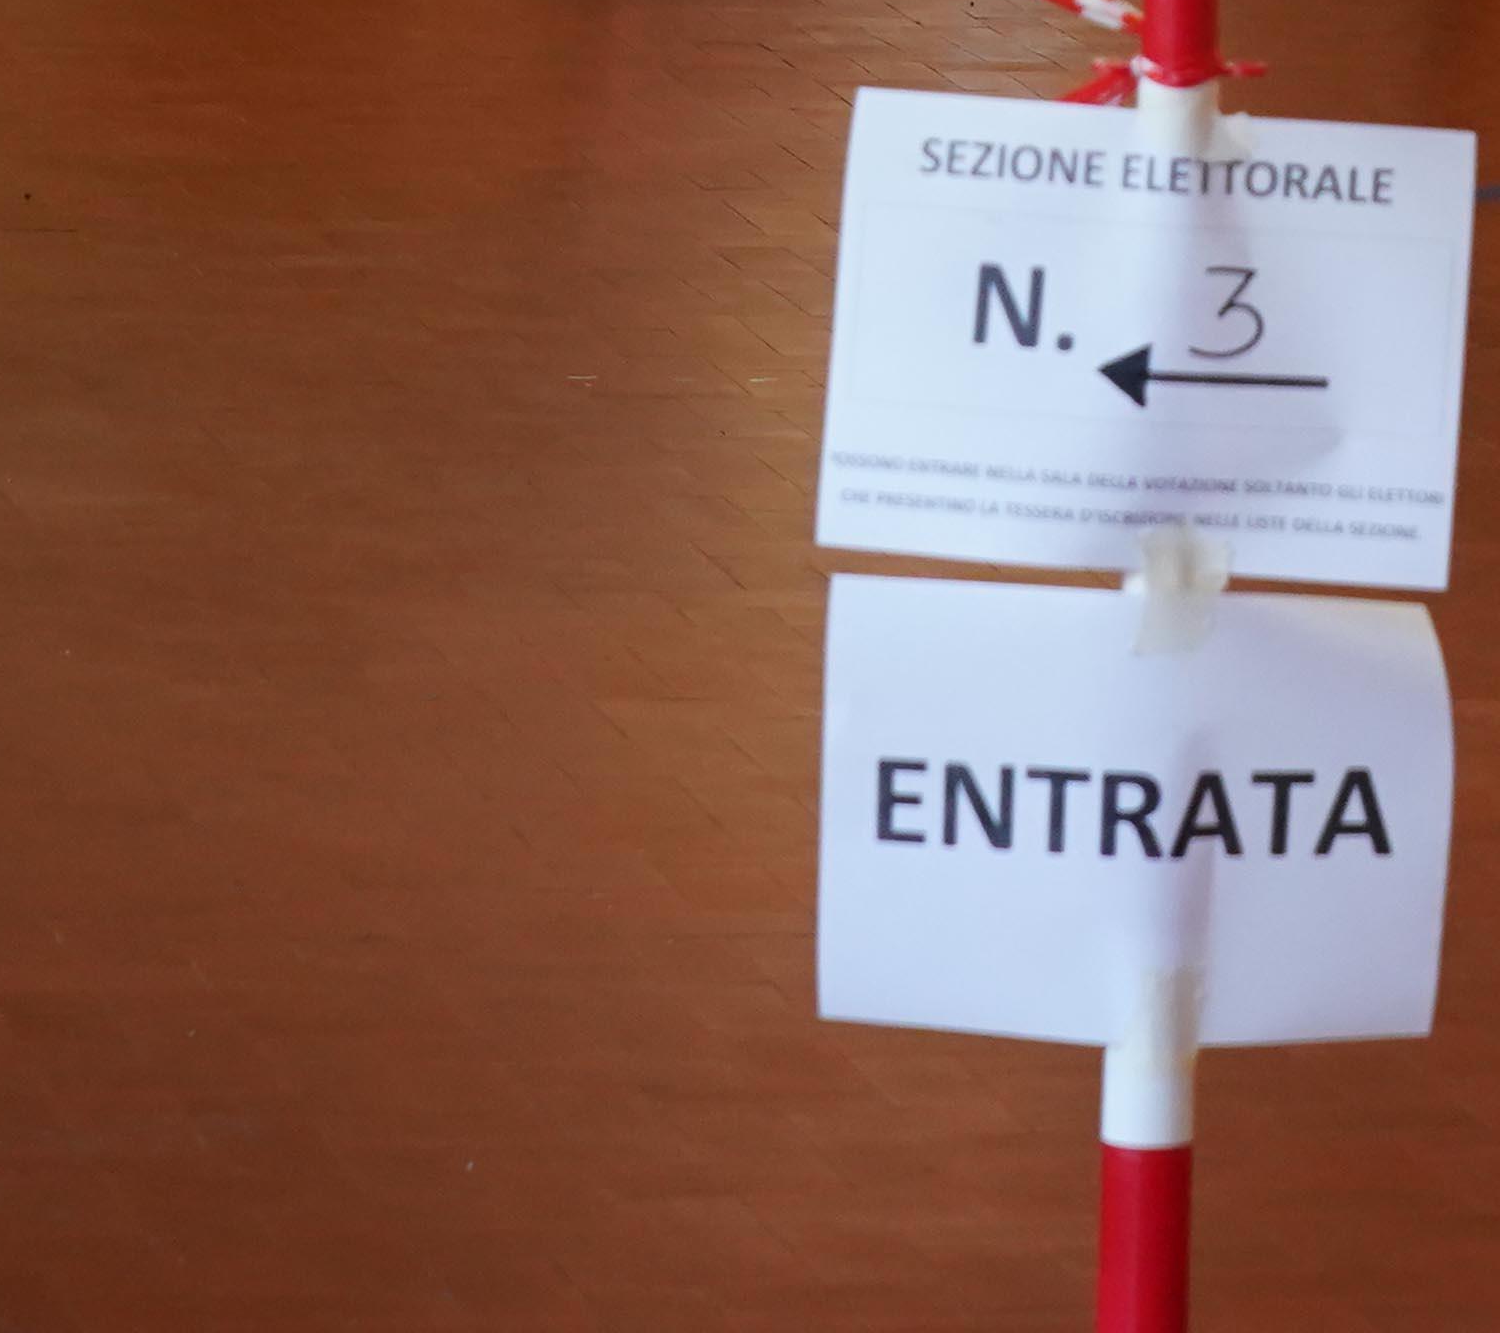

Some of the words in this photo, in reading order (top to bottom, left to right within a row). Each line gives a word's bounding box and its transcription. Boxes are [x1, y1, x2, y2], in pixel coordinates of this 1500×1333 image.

[918, 137, 1105, 187] SEZIONE
[1121, 152, 1395, 206] ELETTORALE
[972, 261, 1075, 351] N.
[1188, 265, 1266, 359] 3
[1042, 465, 1082, 484] SALA
[1088, 468, 1136, 488] DELLA
[876, 757, 1393, 859] ENTRATA
